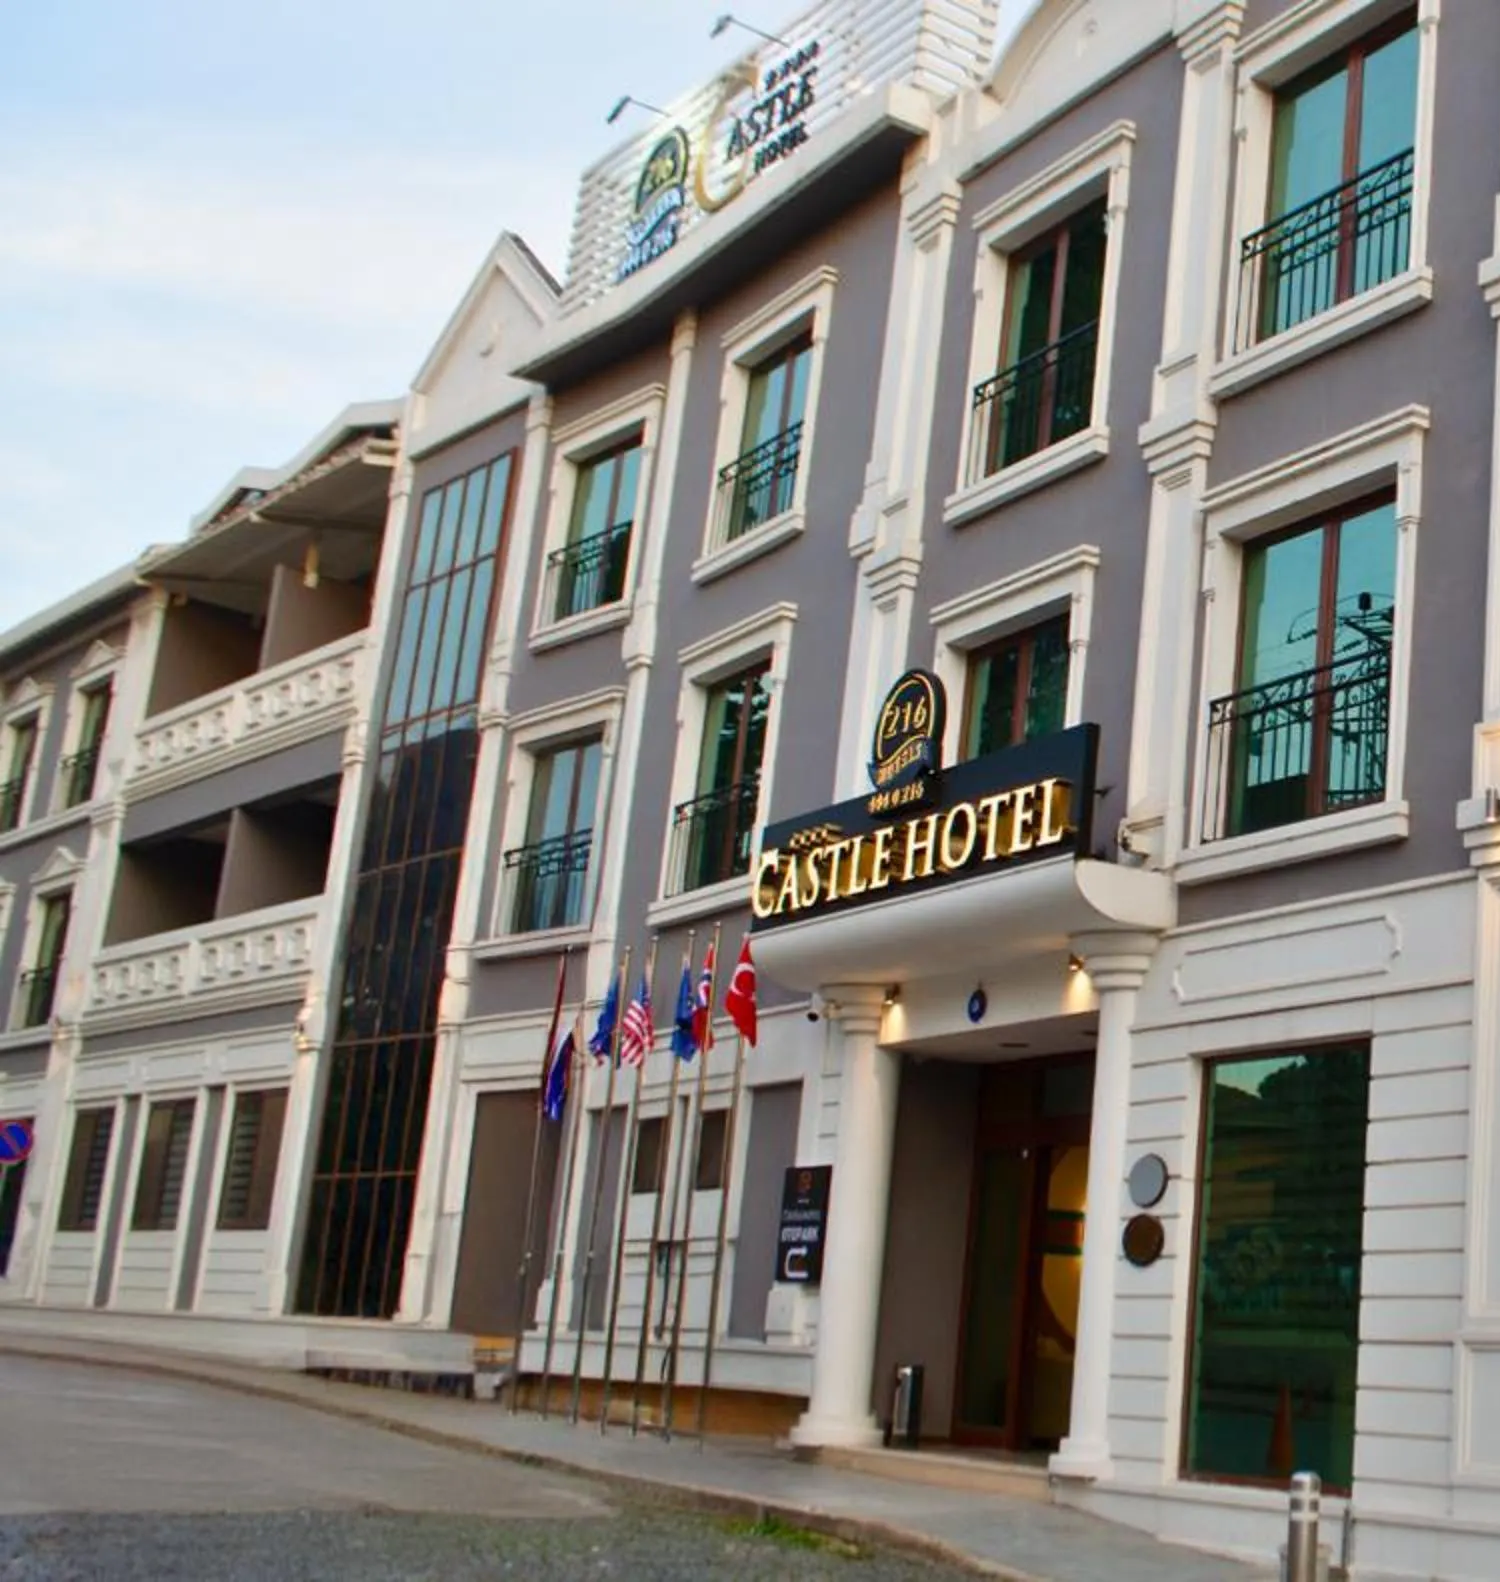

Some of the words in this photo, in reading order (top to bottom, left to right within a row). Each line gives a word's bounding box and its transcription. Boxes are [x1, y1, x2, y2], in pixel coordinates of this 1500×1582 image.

[884, 696, 928, 739] 216
[752, 826, 894, 918] CASTLE
[902, 778, 1066, 881] HOTEL
